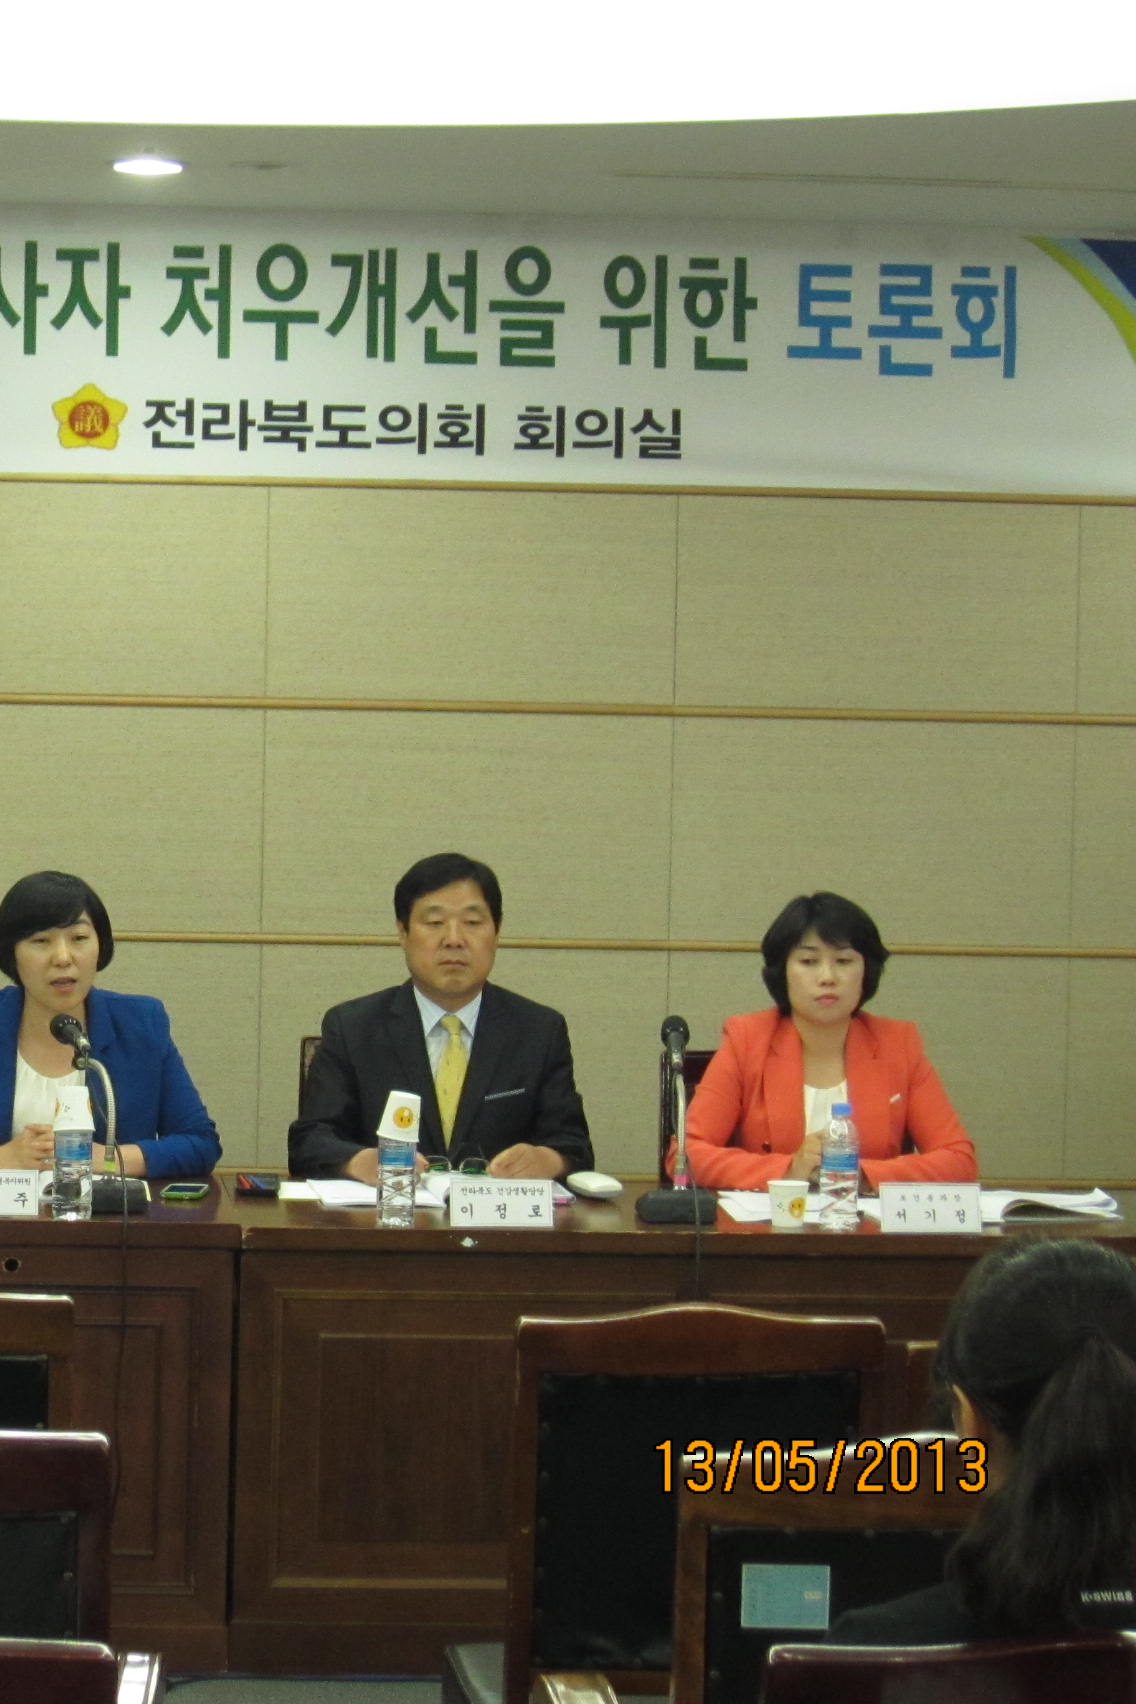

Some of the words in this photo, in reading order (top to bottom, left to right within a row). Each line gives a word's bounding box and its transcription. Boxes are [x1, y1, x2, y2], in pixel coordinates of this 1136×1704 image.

[161, 242, 566, 367] 처우개선을
[600, 254, 758, 371] 위한
[787, 264, 1016, 378] 토론회
[144, 398, 485, 456] 전라북도의회
[514, 406, 681, 459] 회의실
